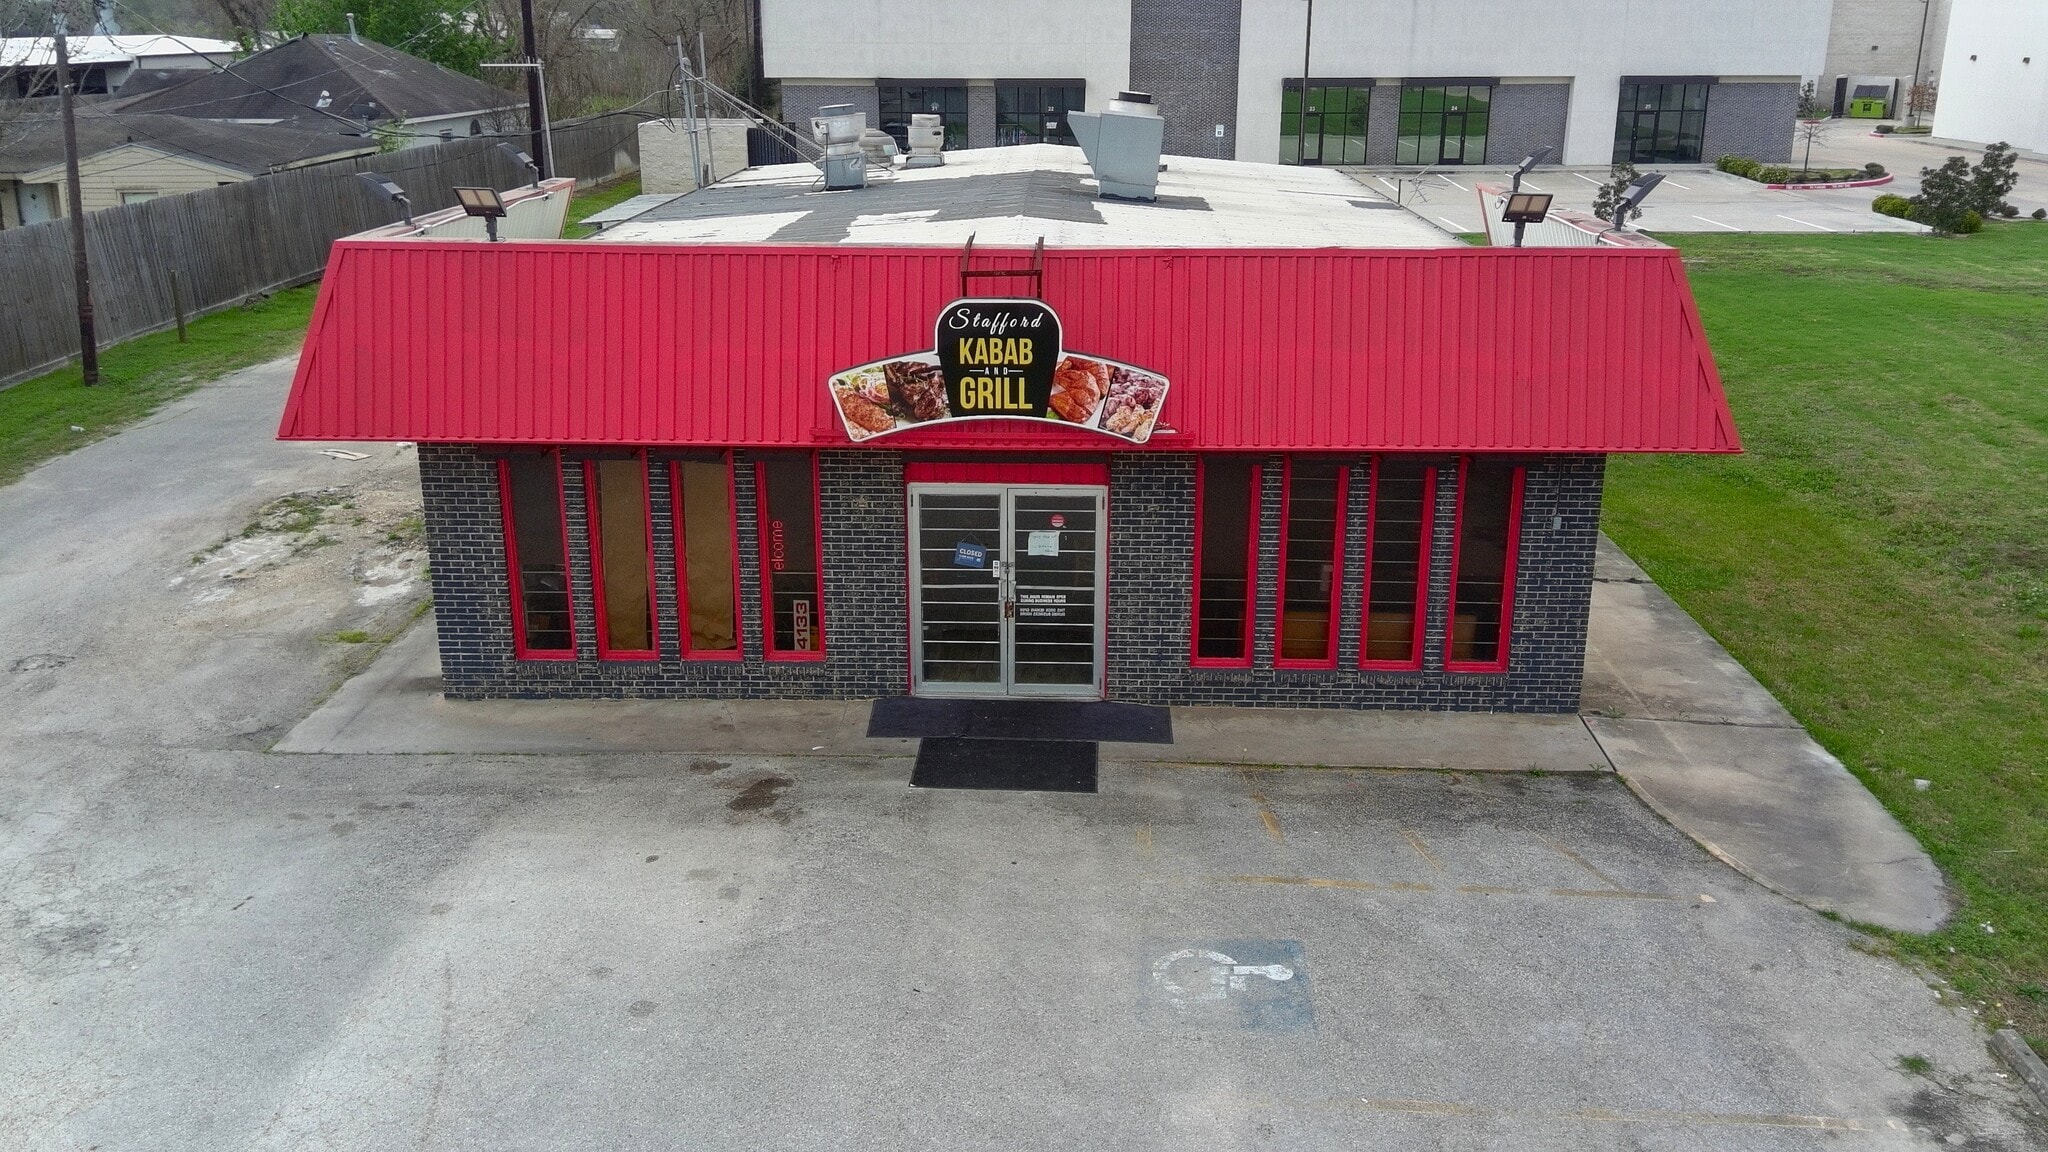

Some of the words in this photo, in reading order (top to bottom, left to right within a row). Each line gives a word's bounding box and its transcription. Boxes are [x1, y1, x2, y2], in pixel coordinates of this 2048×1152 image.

[949, 308, 1044, 335] Stafford
[960, 338, 1033, 364] KABAB
[985, 367, 1008, 375] AND
[960, 377, 1033, 409] GRILL
[959, 548, 983, 557] CLOSED
[796, 602, 808, 649] 4133
